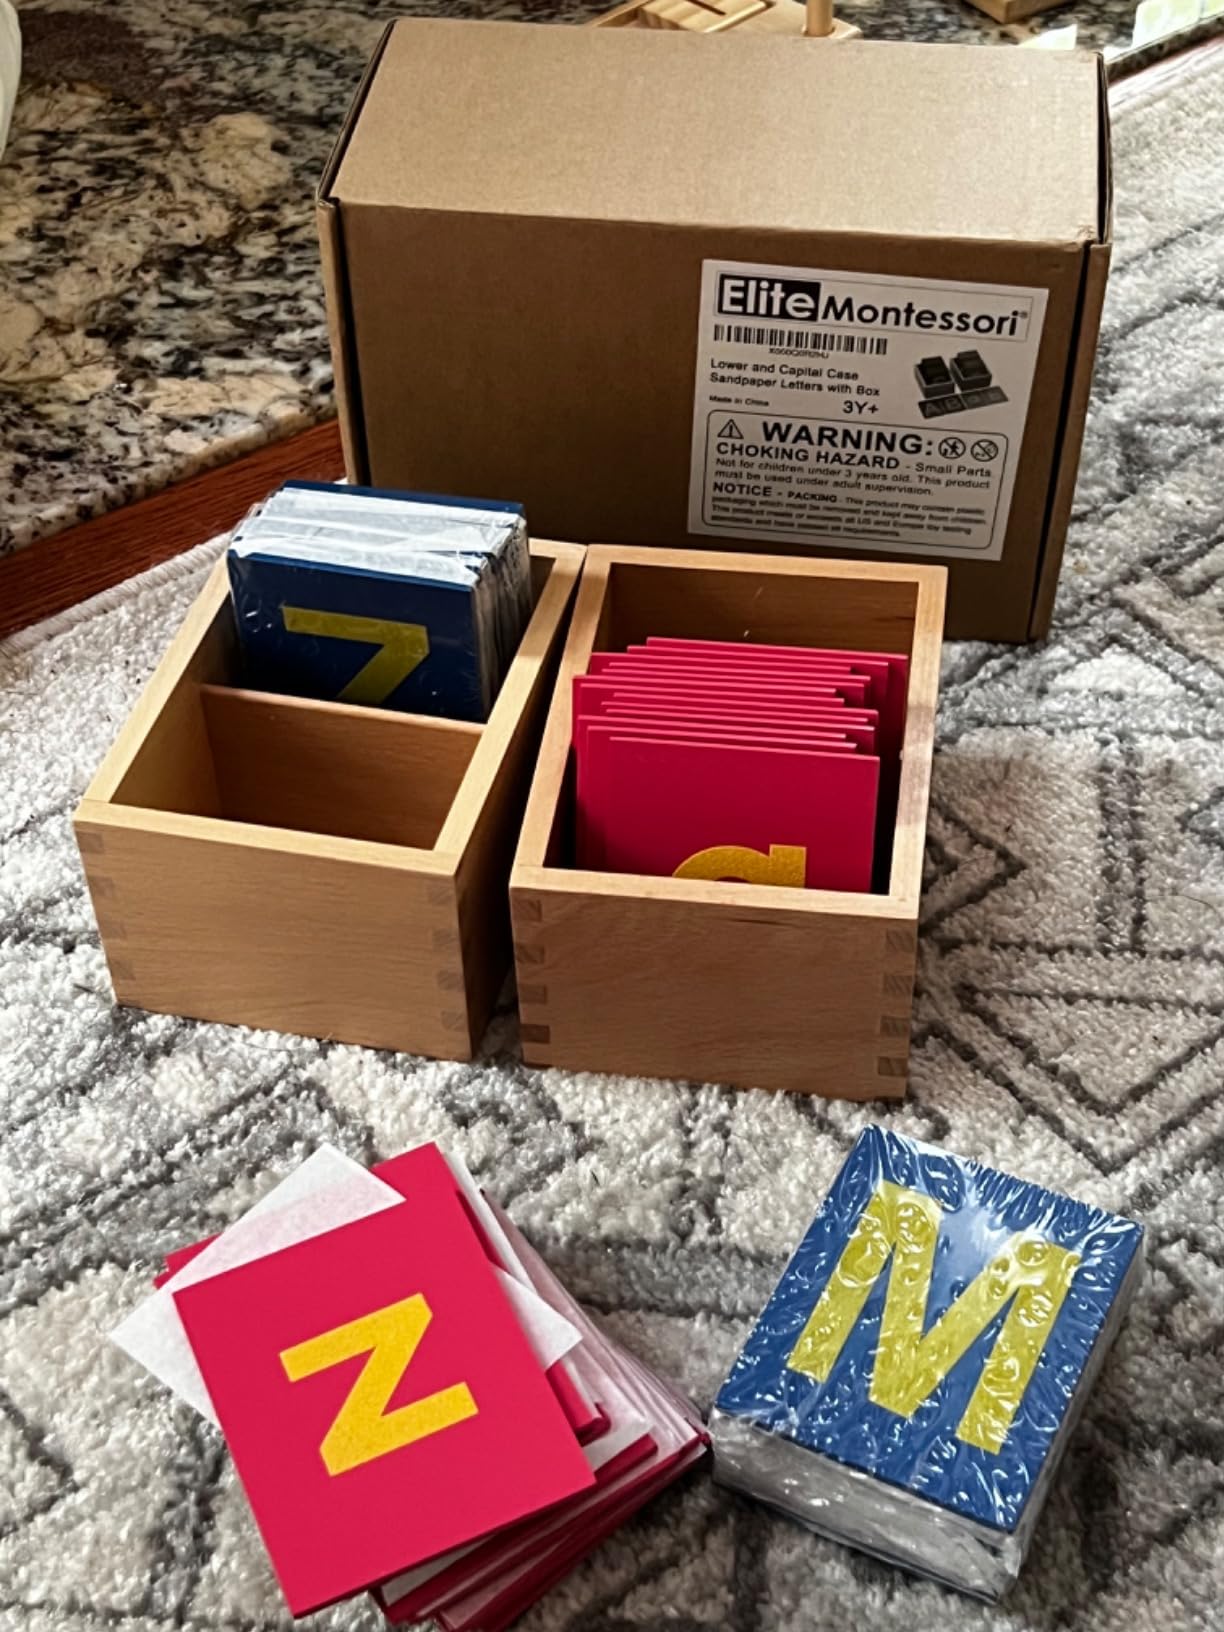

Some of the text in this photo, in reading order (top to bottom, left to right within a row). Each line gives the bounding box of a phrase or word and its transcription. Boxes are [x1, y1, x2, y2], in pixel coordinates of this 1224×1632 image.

[722, 279, 1019, 337] Elite Montessori
[710, 357, 860, 381] Lower and Capital Case
[710, 371, 881, 397] Sandpaper Letters with Box
[842, 400, 880, 415] 3Y+
[762, 420, 932, 457] WARNING:
[715, 441, 810, 462] CHOKING
[816, 450, 901, 471] HAZARD
[914, 462, 953, 475] Small
[956, 465, 992, 478] Parts
[715, 458, 736, 468] Not
[739, 459, 755, 470] for
[758, 462, 804, 473] children
[808, 467, 842, 477] under
[856, 471, 888, 482] years
[917, 474, 942, 486] This
[945, 478, 991, 490] product
[712, 481, 773, 498] NOTICE
[787, 490, 838, 504] PACKING
[714, 469, 934, 497] must be used under adult supervision.
[786, 1179, 1081, 1456] M
